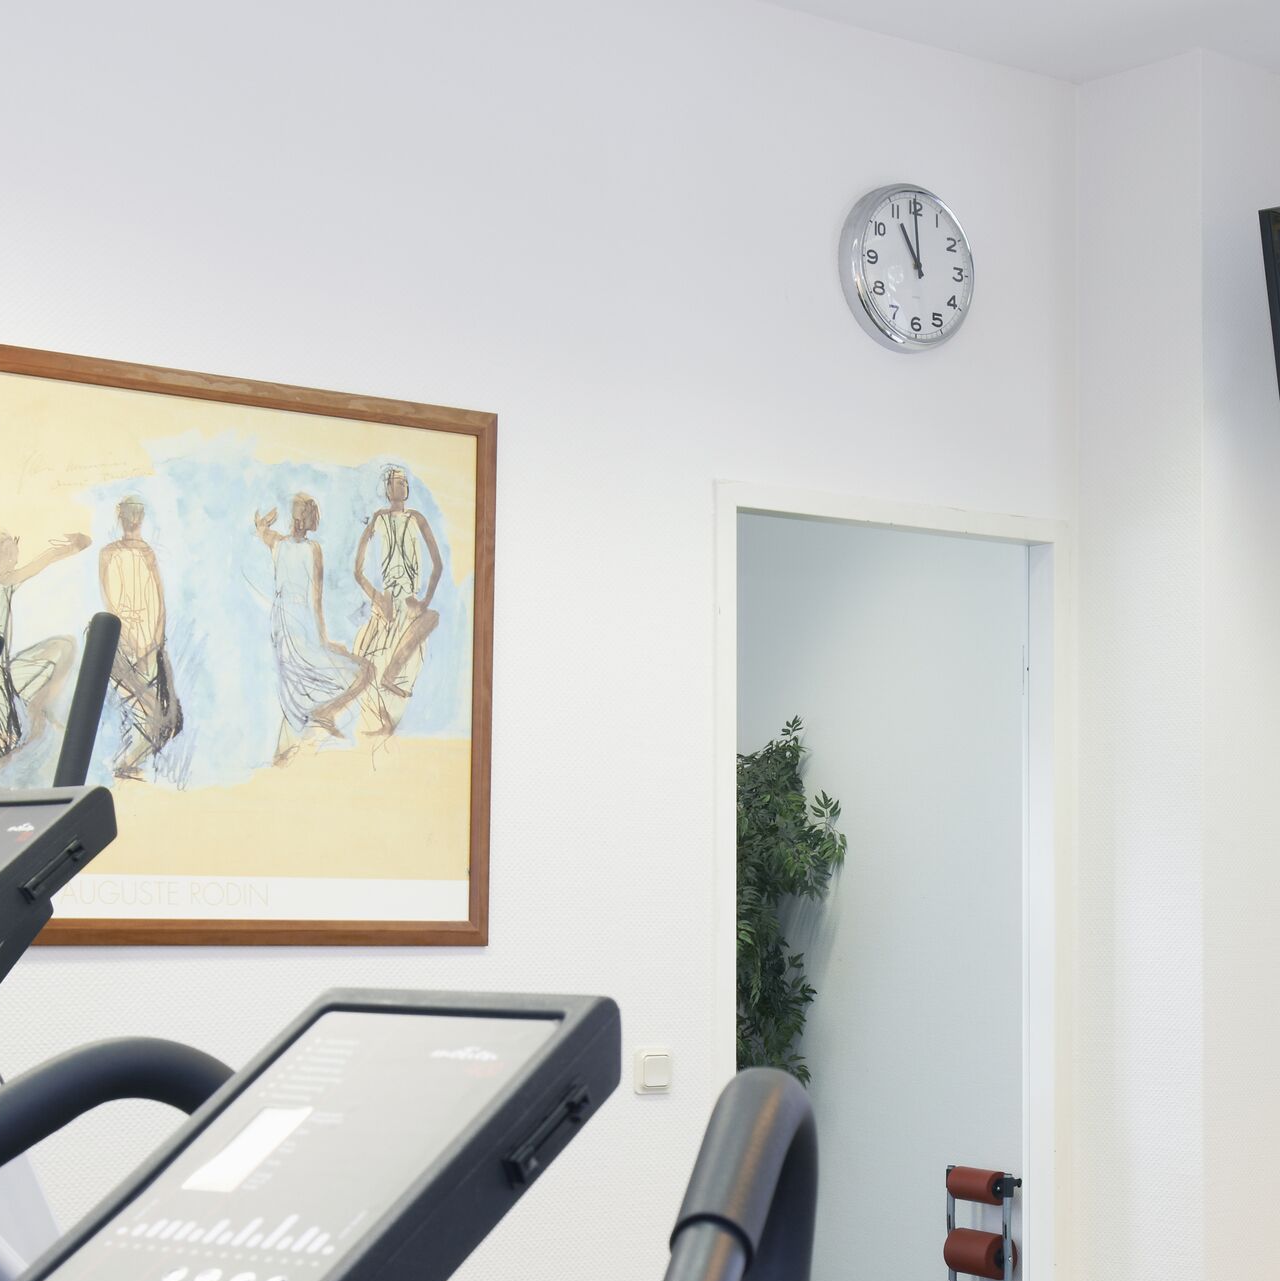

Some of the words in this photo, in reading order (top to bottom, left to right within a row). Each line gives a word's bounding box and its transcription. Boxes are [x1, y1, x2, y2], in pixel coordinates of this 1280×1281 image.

[891, 203, 900, 219] 11
[874, 220, 886, 236] 10
[946, 237, 957, 253] 2
[866, 249, 879, 265] 9
[952, 266, 964, 282] 3
[872, 280, 886, 296] 8
[946, 295, 958, 310] 4
[888, 304, 900, 320] 7
[931, 312, 944, 328] 5
[910, 316, 922, 332] 6
[59, 879, 180, 906] AUGUSTE
[189, 880, 270, 908] RODIN
